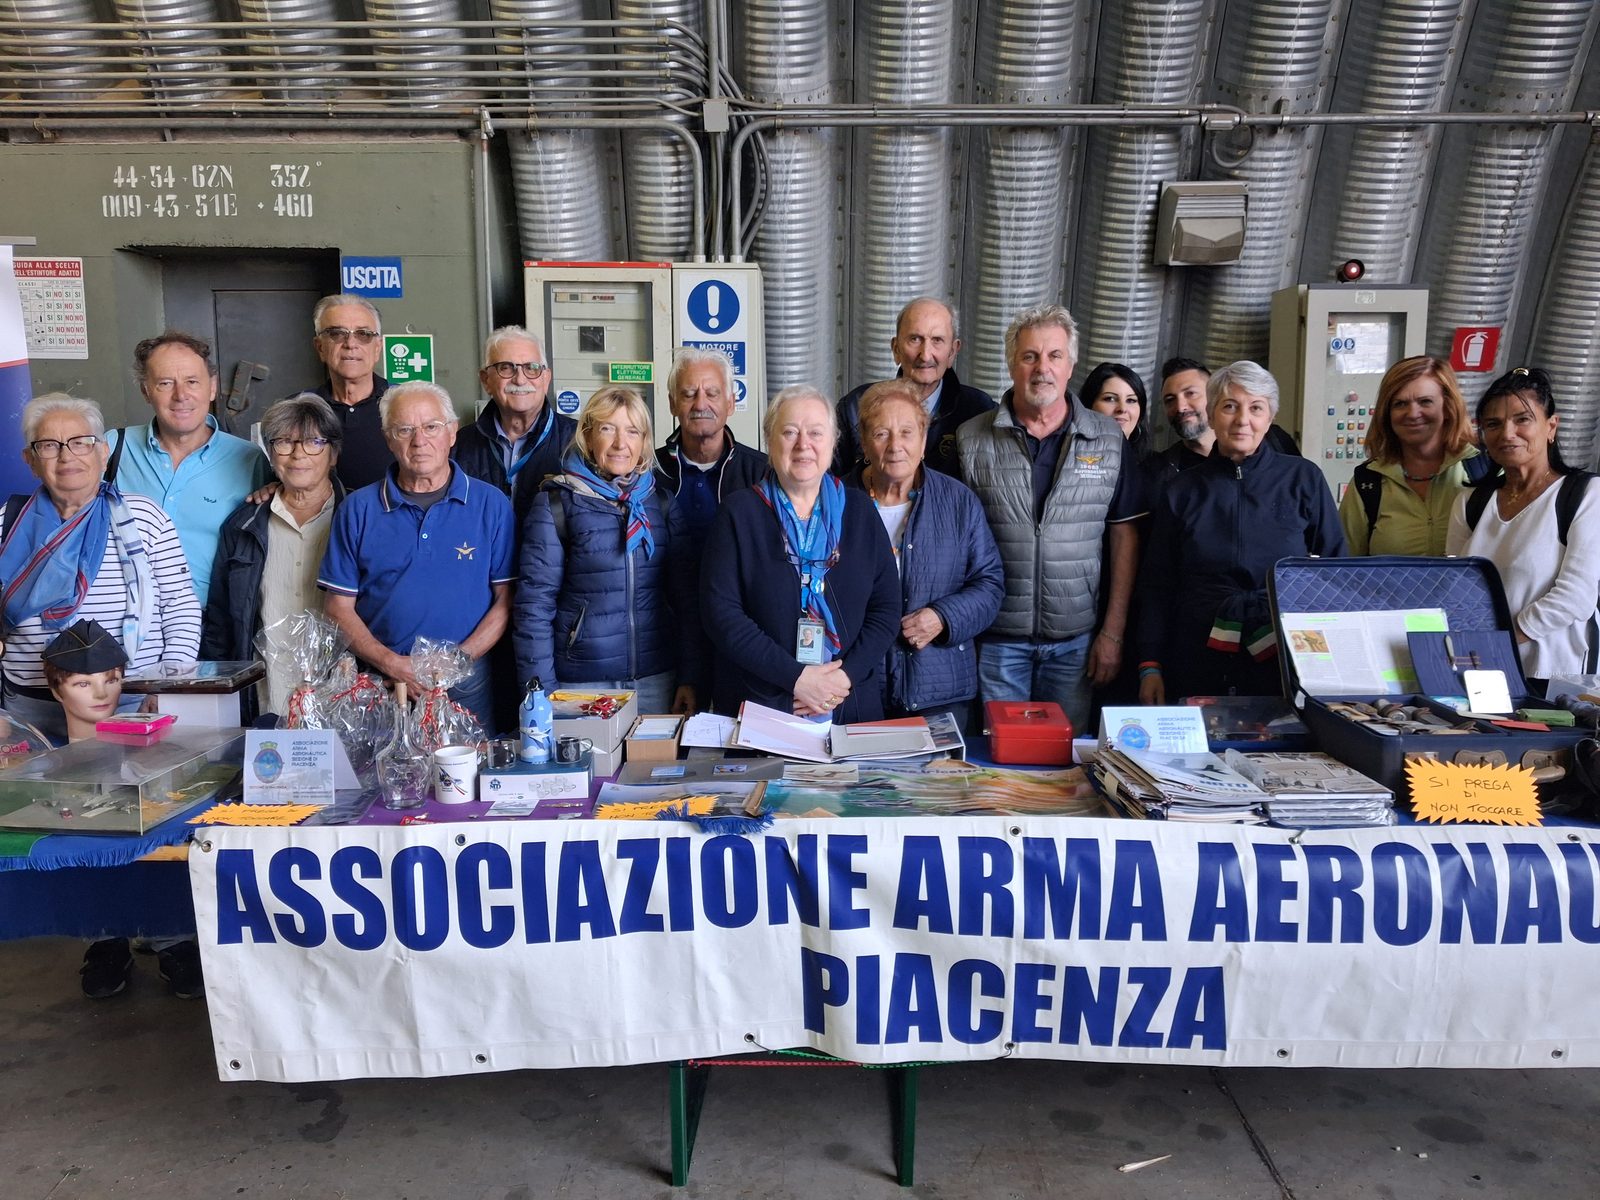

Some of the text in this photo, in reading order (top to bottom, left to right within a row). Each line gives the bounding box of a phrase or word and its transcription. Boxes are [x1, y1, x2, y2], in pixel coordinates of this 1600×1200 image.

[58, 269, 80, 277] ADATTO
[342, 266, 401, 289] USCITA
[699, 343, 739, 351] MOTORE
[1428, 776, 1512, 792] SI PREGA
[1463, 790, 1477, 798] DI
[1430, 802, 1524, 816] NON TOCCARE
[215, 834, 1600, 952] ASSOCIAZIONE ARMA AERONAU
[803, 948, 1227, 1051] PIACENZA
